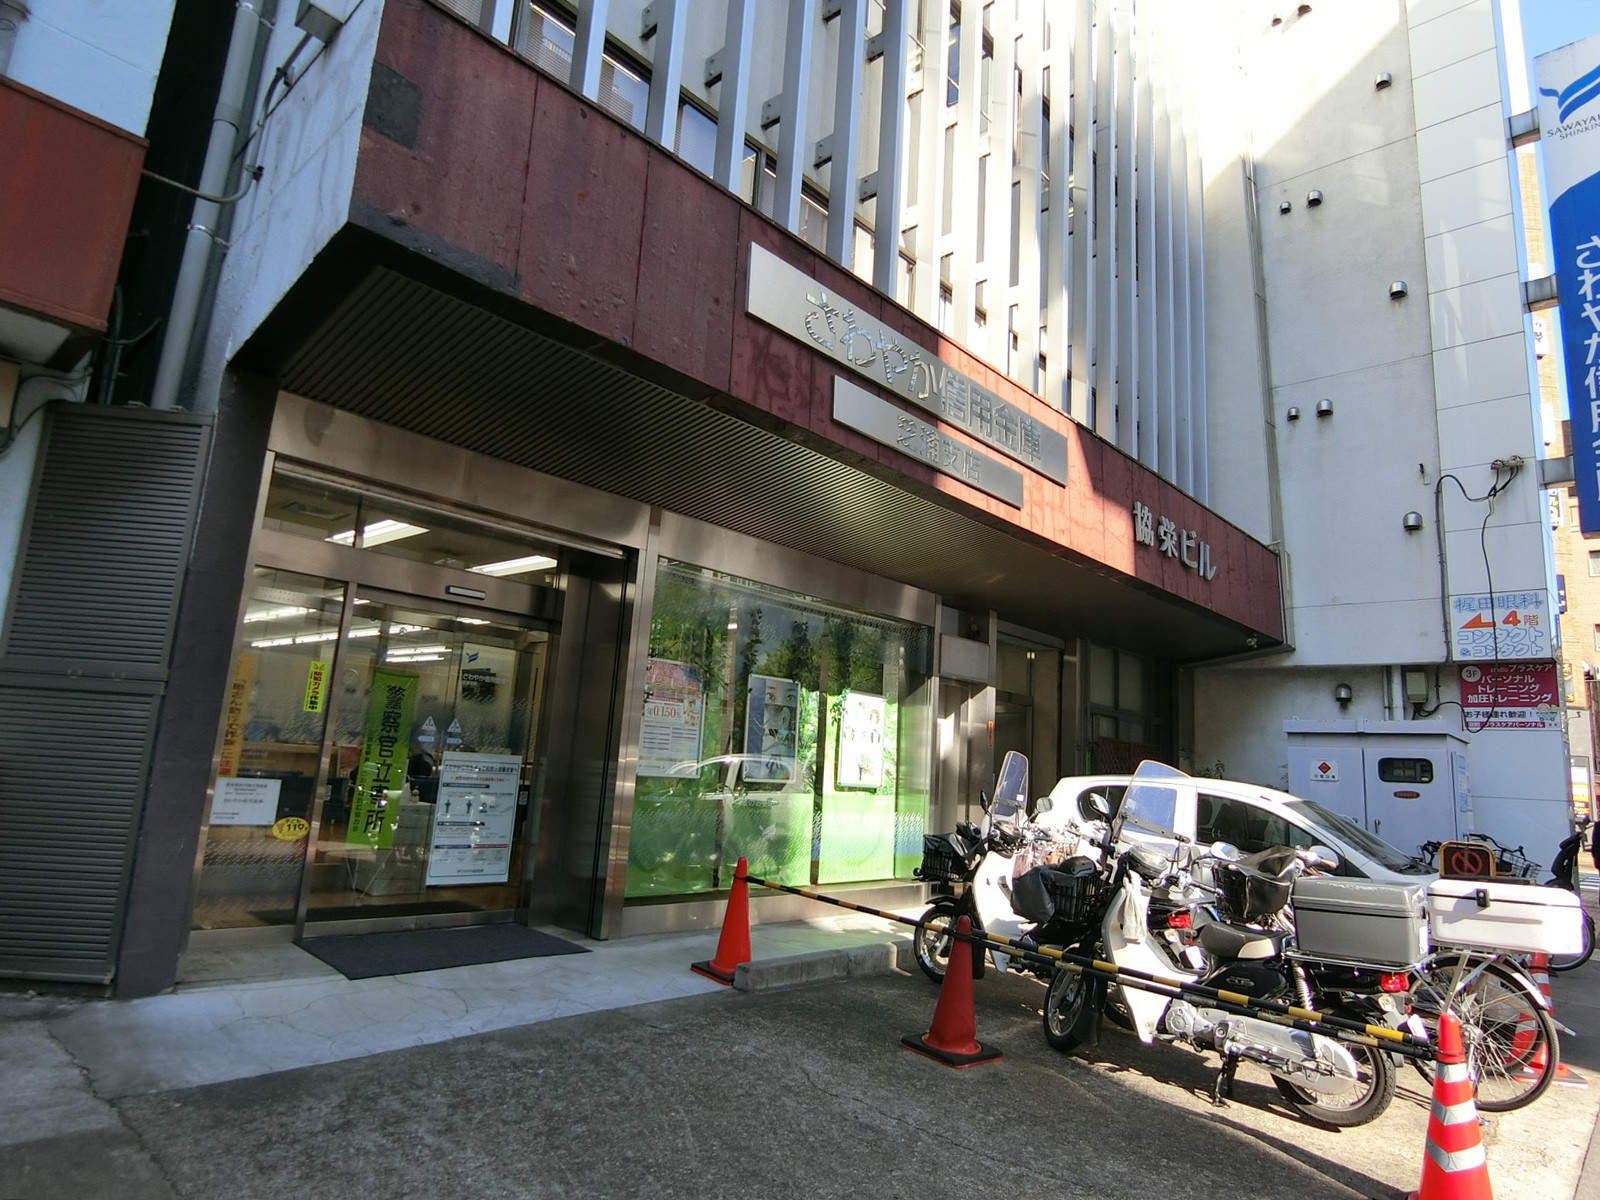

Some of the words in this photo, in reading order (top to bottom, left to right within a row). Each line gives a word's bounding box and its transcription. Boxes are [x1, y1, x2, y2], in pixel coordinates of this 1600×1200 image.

[804, 291, 1042, 463] さわやか信用金庫
[896, 414, 981, 484] 芝浦支店
[1132, 501, 1217, 581] 協栄ビル
[1457, 627, 1544, 645] コンタクト
[1472, 642, 1544, 657] コンタクト
[1465, 669, 1478, 678] 3F
[1480, 674, 1535, 684] パーソナル
[1477, 683, 1541, 694] トレーニング
[1467, 693, 1553, 704] 加圧トレーニング
